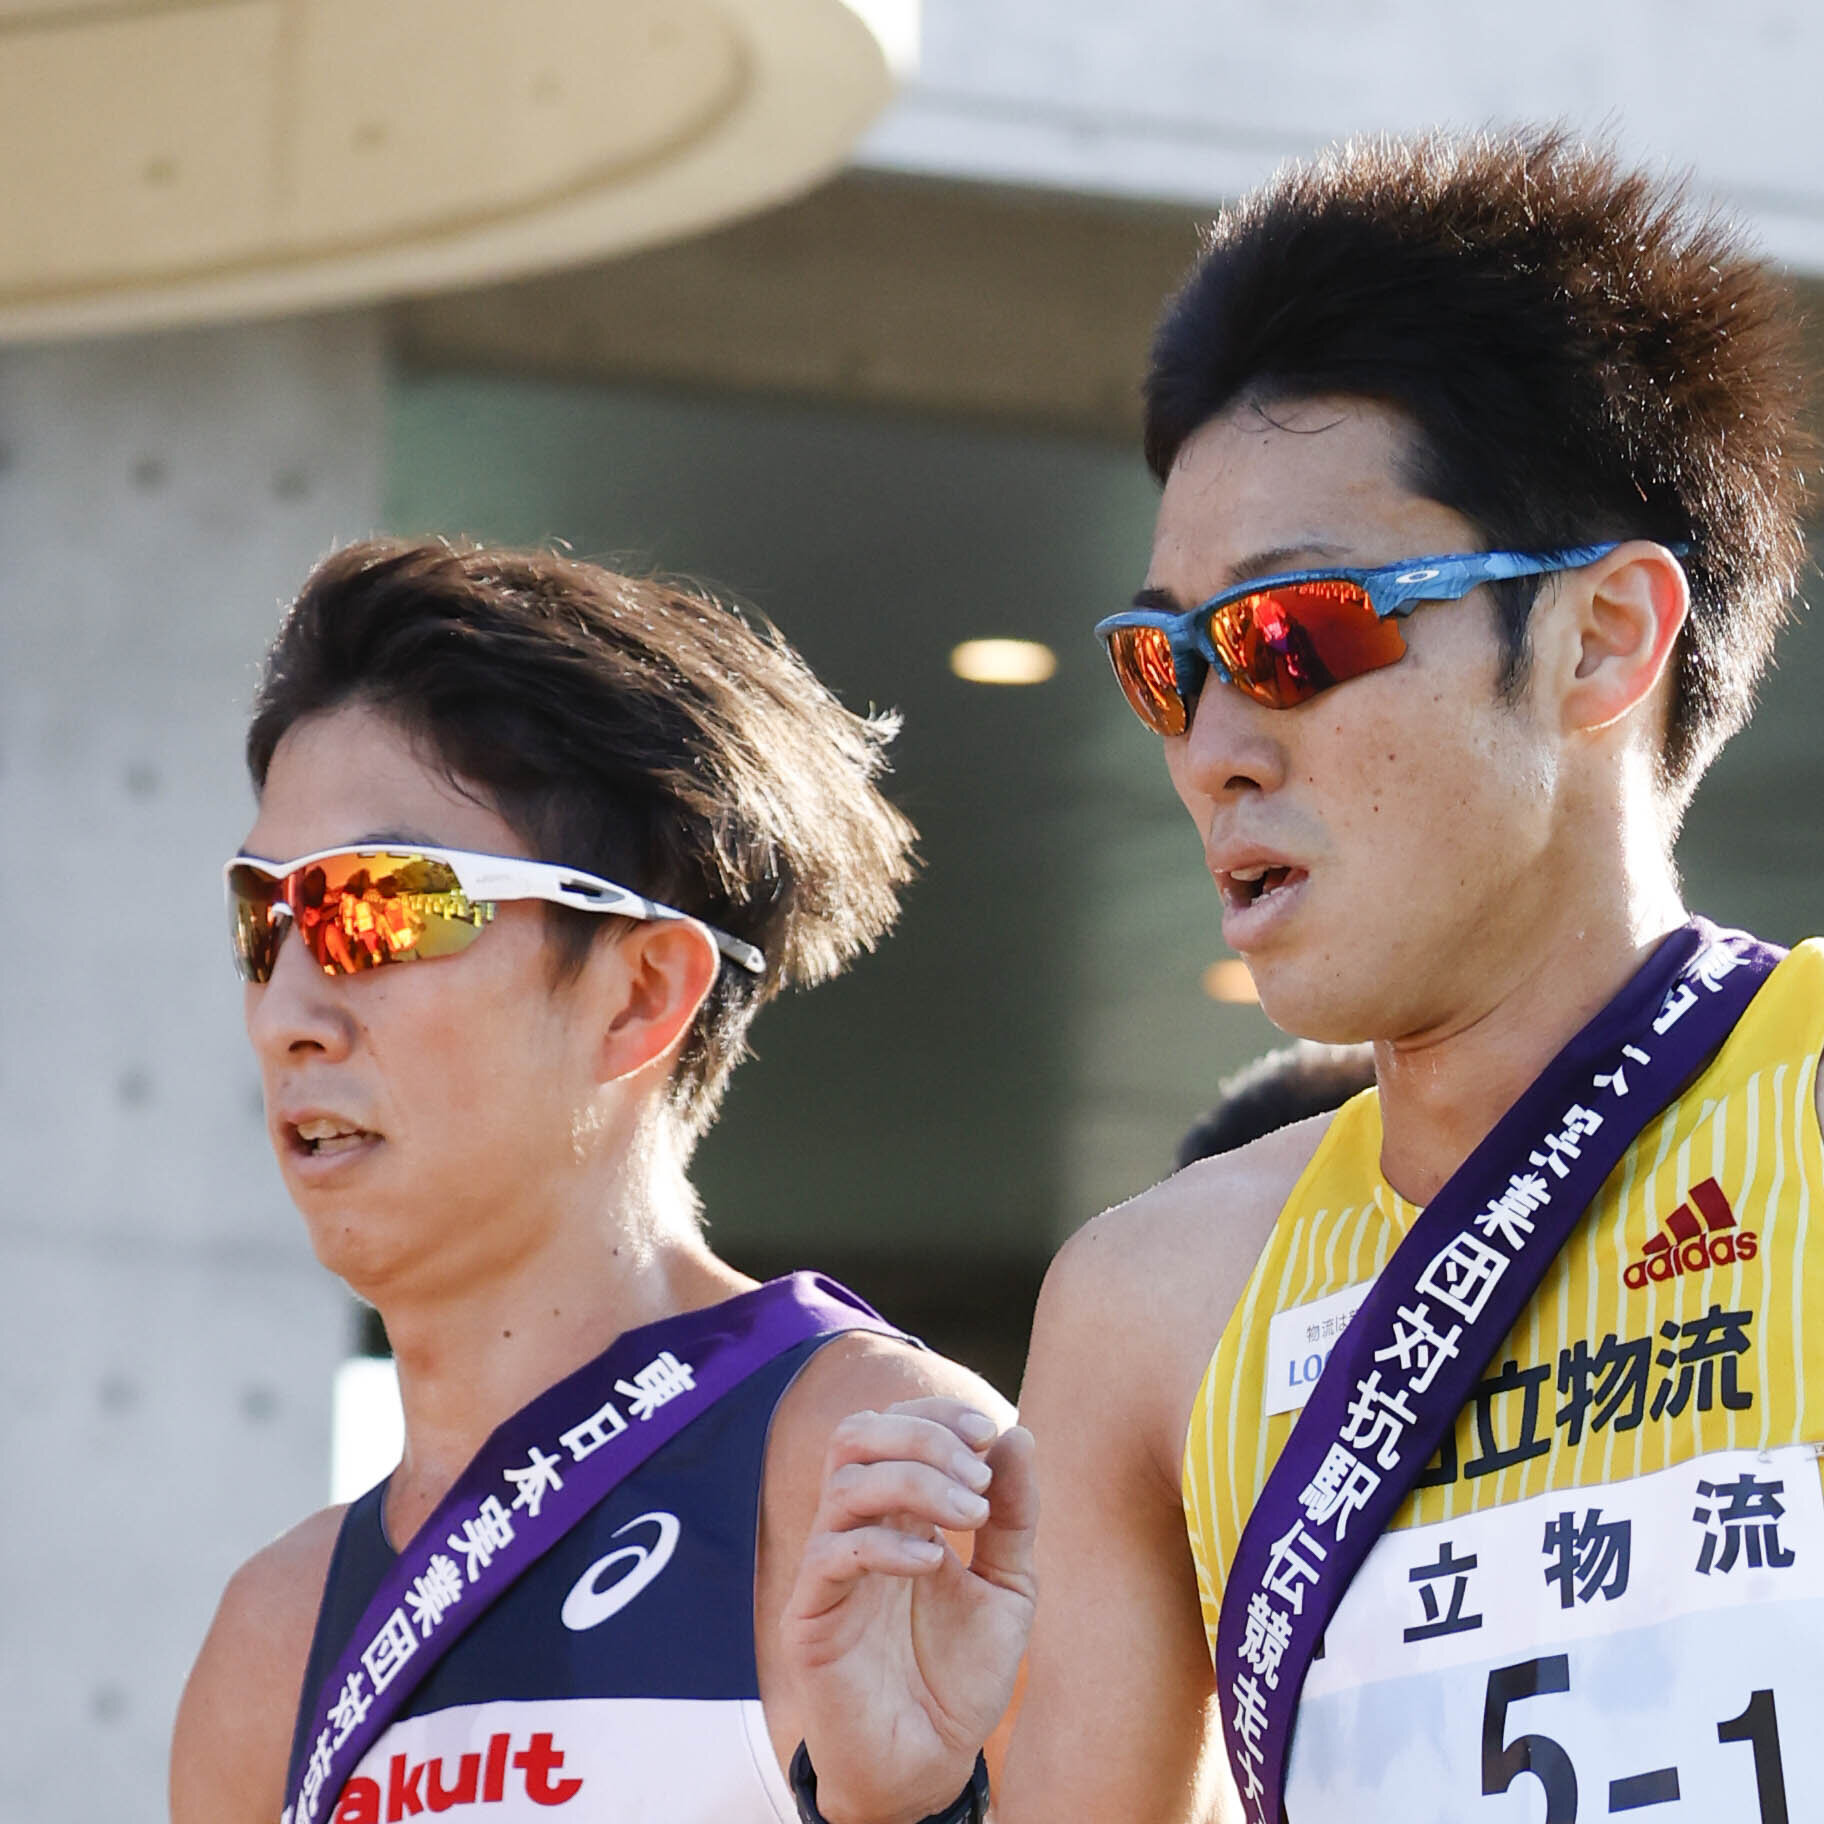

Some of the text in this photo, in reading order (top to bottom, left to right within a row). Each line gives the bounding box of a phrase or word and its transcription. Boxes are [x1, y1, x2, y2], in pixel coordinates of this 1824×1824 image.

[1623, 1230, 1758, 1290] adidas
[1306, 1310, 1357, 1343] 物流は
[1288, 1350, 1331, 1387] LO
[1314, 1473, 1796, 1661] 立物流
